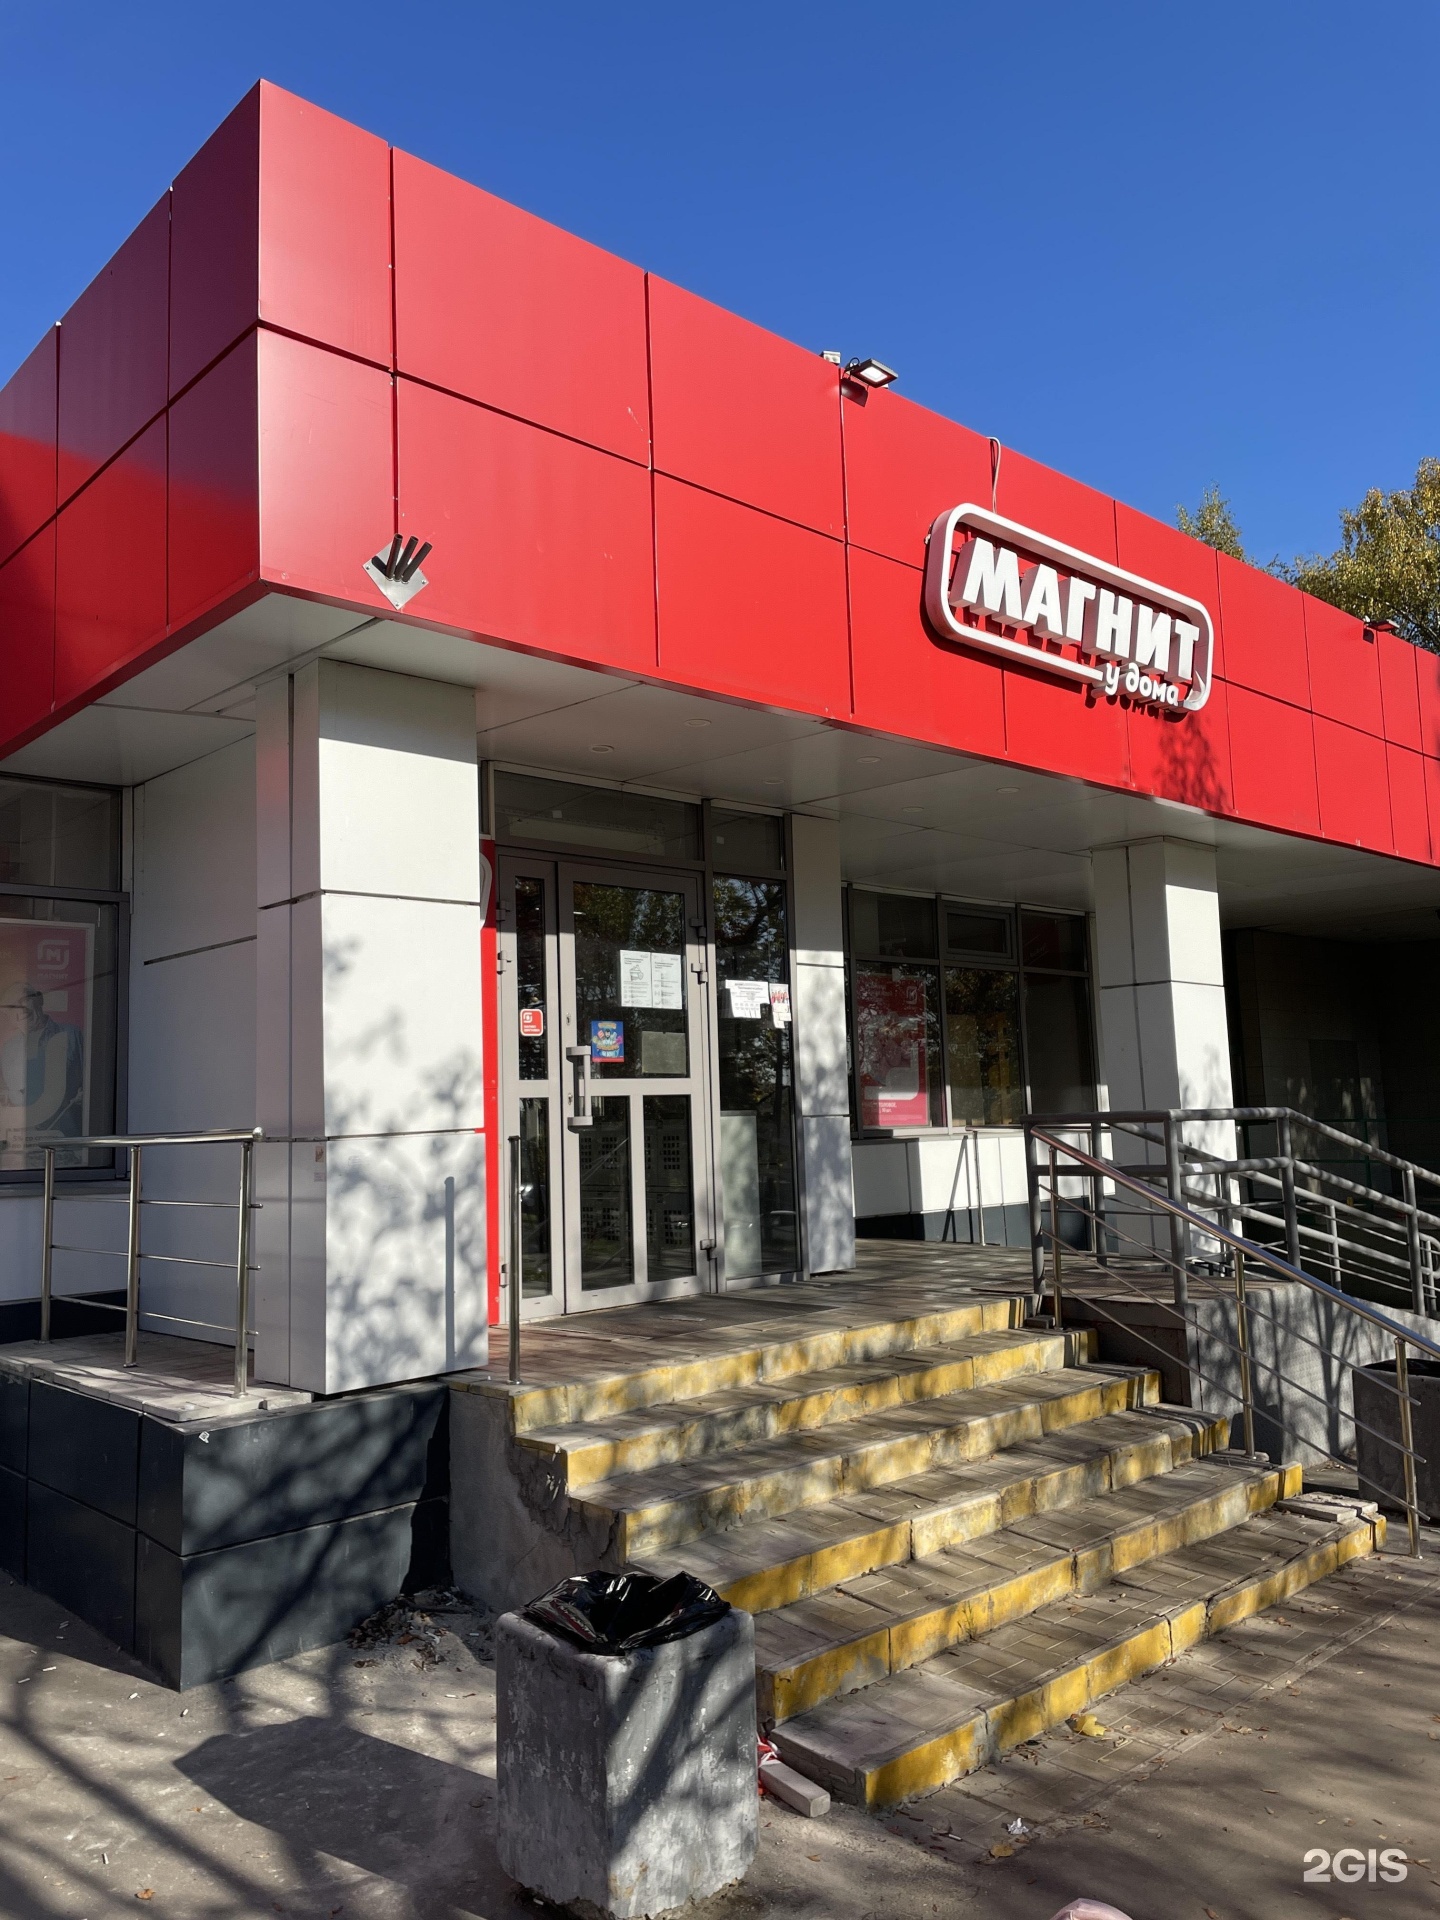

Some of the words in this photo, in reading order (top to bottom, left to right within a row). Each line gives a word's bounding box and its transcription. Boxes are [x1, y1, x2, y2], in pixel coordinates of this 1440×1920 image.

[961, 536, 1200, 682] МАГНИТ
[1104, 662, 1121, 696] у
[1124, 662, 1180, 706] дома
